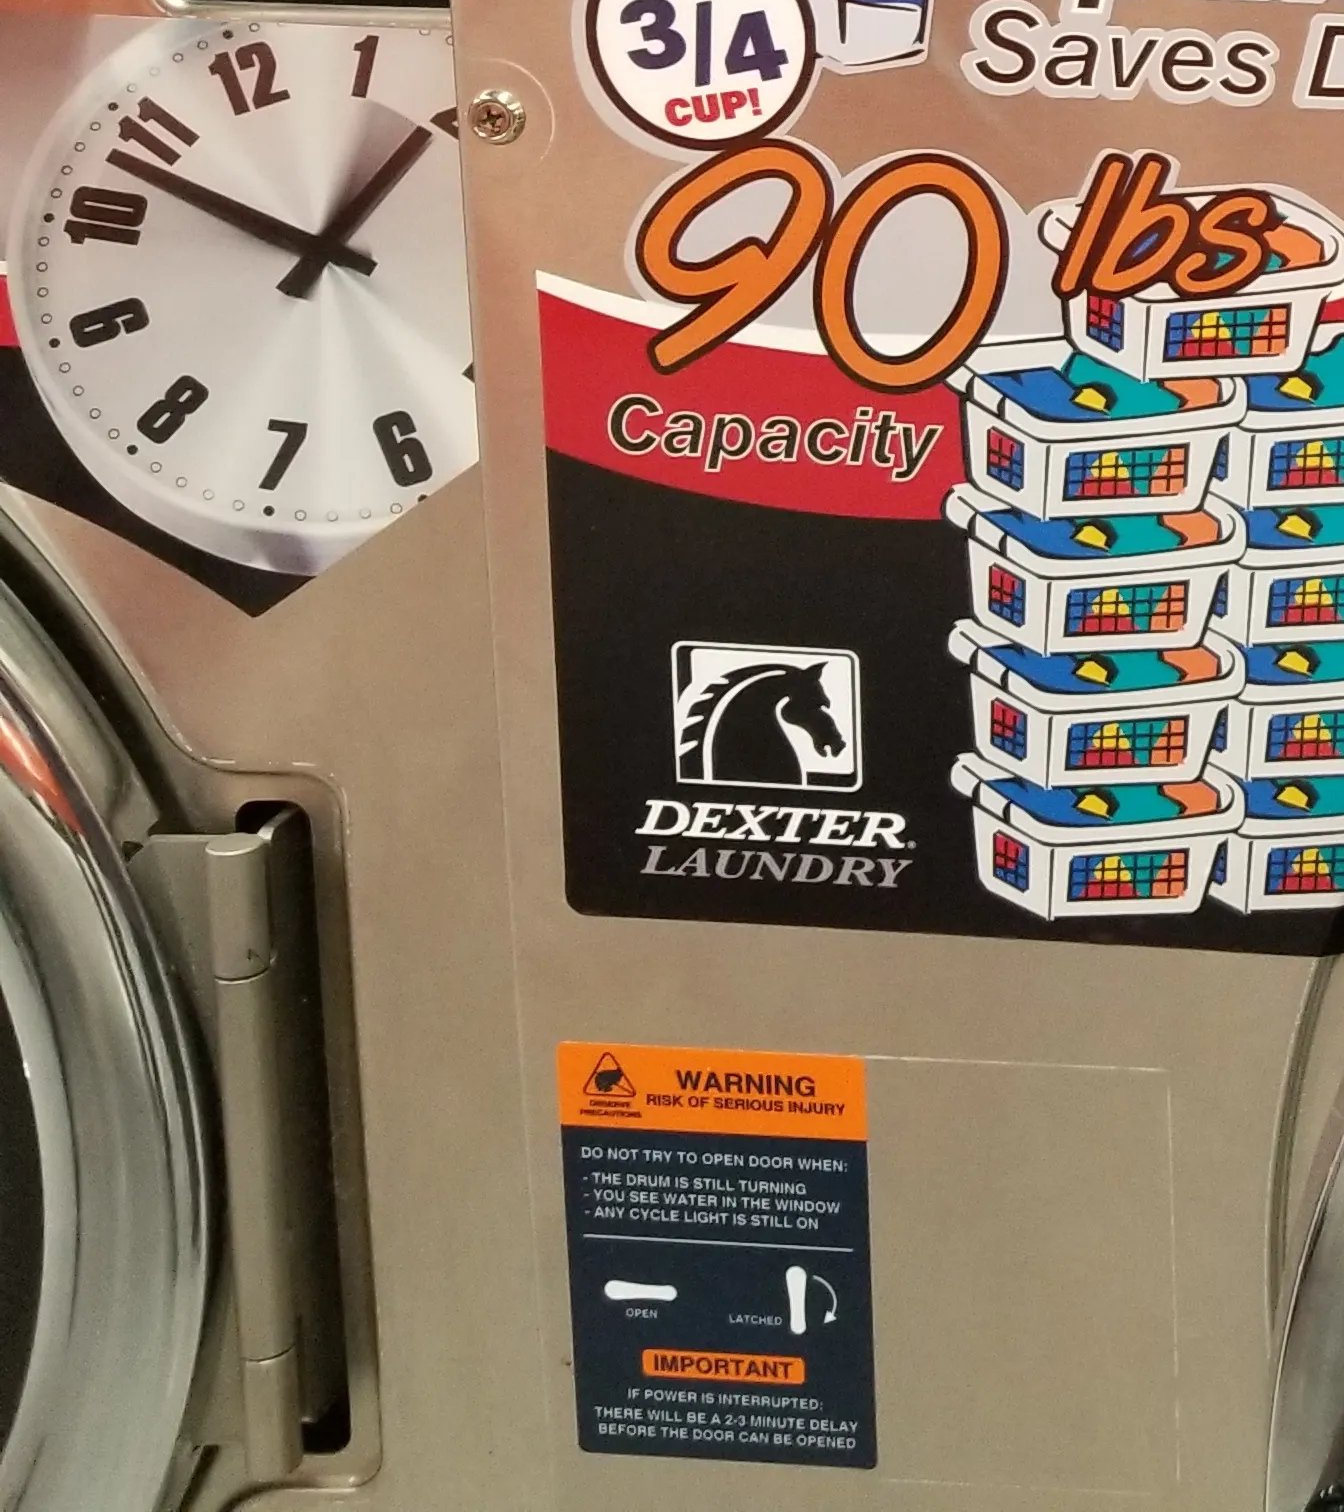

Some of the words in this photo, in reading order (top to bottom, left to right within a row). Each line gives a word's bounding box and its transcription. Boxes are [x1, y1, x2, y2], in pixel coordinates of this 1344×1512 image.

[351, 35, 379, 98] 1
[978, 13, 1274, 97] Saves
[208, 41, 291, 115] 12
[664, 88, 762, 126] CUP!
[119, 97, 200, 166] 11
[63, 186, 148, 245] 10
[635, 138, 1008, 394] 90
[1051, 152, 1278, 299] lbs
[373, 411, 432, 487] 6
[607, 393, 943, 481] Capacity
[635, 799, 908, 850] DEXTER
[641, 845, 912, 888] LAUNDRY
[676, 1070, 816, 1096] WARNING
[646, 1094, 683, 1107] RISK
[688, 1097, 709, 1107] OF
[714, 1097, 783, 1112] SERIOUS
[787, 1101, 845, 1115] INJURY
[581, 1147, 602, 1159] DO
[607, 1148, 638, 1160] NOT
[642, 1149, 672, 1162] TRY
[677, 1151, 697, 1164] TO
[702, 1153, 744, 1166] OPEN
[749, 1155, 793, 1169] DOOR
[798, 1157, 848, 1172] WHEN:
[592, 1173, 622, 1185] THE
[626, 1174, 670, 1188] DRUM
[675, 1176, 688, 1188] IS
[693, 1178, 734, 1192] STILL
[739, 1180, 806, 1194] TURNING
[593, 1189, 625, 1202] YOU
[629, 1191, 660, 1204] SEE
[663, 1193, 718, 1207] WATER
[722, 1195, 736, 1207] IN
[742, 1196, 770, 1209] THE
[775, 1198, 840, 1213] WINDOW
[593, 1207, 624, 1219] ANY
[629, 1208, 679, 1222] CYCLE
[684, 1211, 726, 1225] LIGHT
[733, 1213, 747, 1225] IS
[751, 1214, 792, 1228] STILL
[797, 1217, 818, 1229] ON
[653, 1354, 792, 1379] IMPORTANT
[628, 1388, 639, 1399] IF
[645, 1389, 696, 1402] POWER
[702, 1392, 714, 1403] IS
[718, 1393, 823, 1410] INTERRUPTED:
[595, 1406, 643, 1420] THERE
[648, 1408, 682, 1422] WILL
[687, 1412, 706, 1423] BE
[711, 1413, 720, 1424] A
[724, 1414, 745, 1426] 2-3
[750, 1414, 805, 1429] MINUTE
[810, 1418, 858, 1432] DELAY
[598, 1423, 656, 1436] BEFORE
[660, 1426, 688, 1438] THE
[693, 1428, 734, 1441] DOOR
[739, 1430, 769, 1443] CAN
[774, 1432, 791, 1445] BE
[797, 1434, 856, 1448] OPENED
